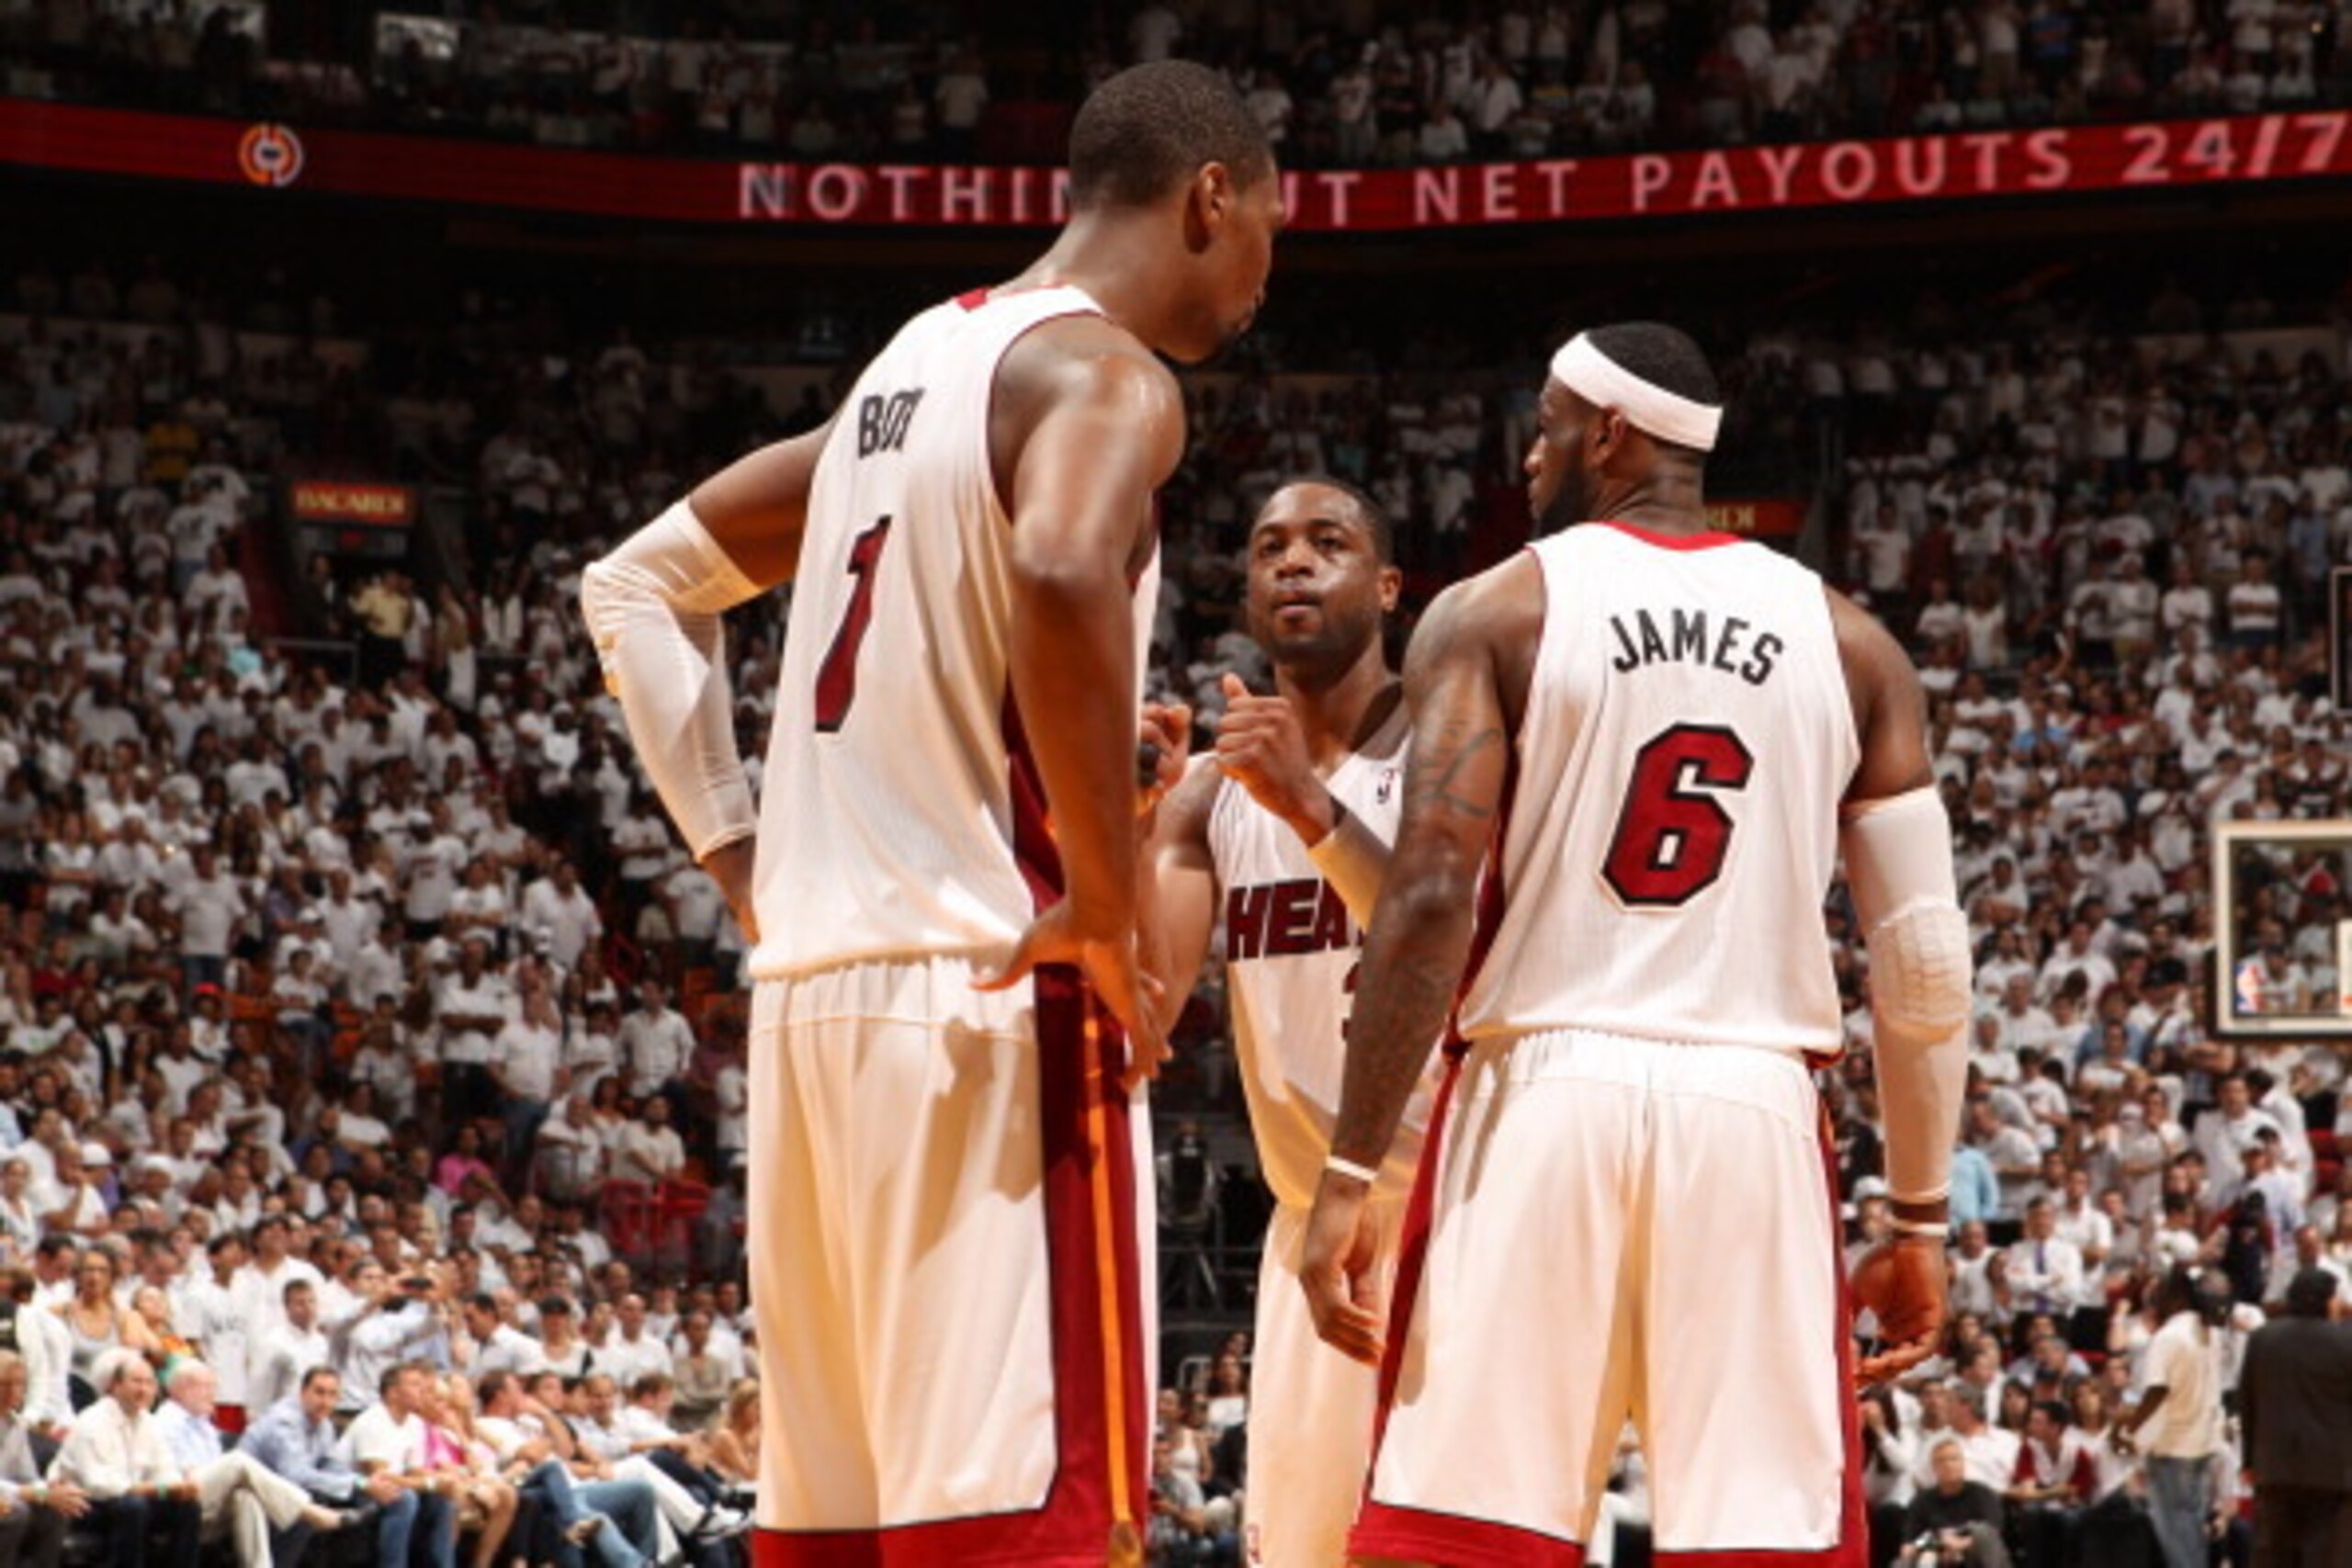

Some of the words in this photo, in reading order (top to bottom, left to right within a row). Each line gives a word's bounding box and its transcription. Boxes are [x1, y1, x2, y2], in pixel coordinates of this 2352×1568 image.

[1414, 159, 1577, 222] NET
[1631, 130, 2071, 211] PAYOUTS
[2120, 113, 2348, 182] 24/7
[814, 514, 892, 732] 1
[1610, 608, 1784, 685] JAMES
[1600, 722, 1755, 907] 6
[1227, 878, 1365, 961] HEA
